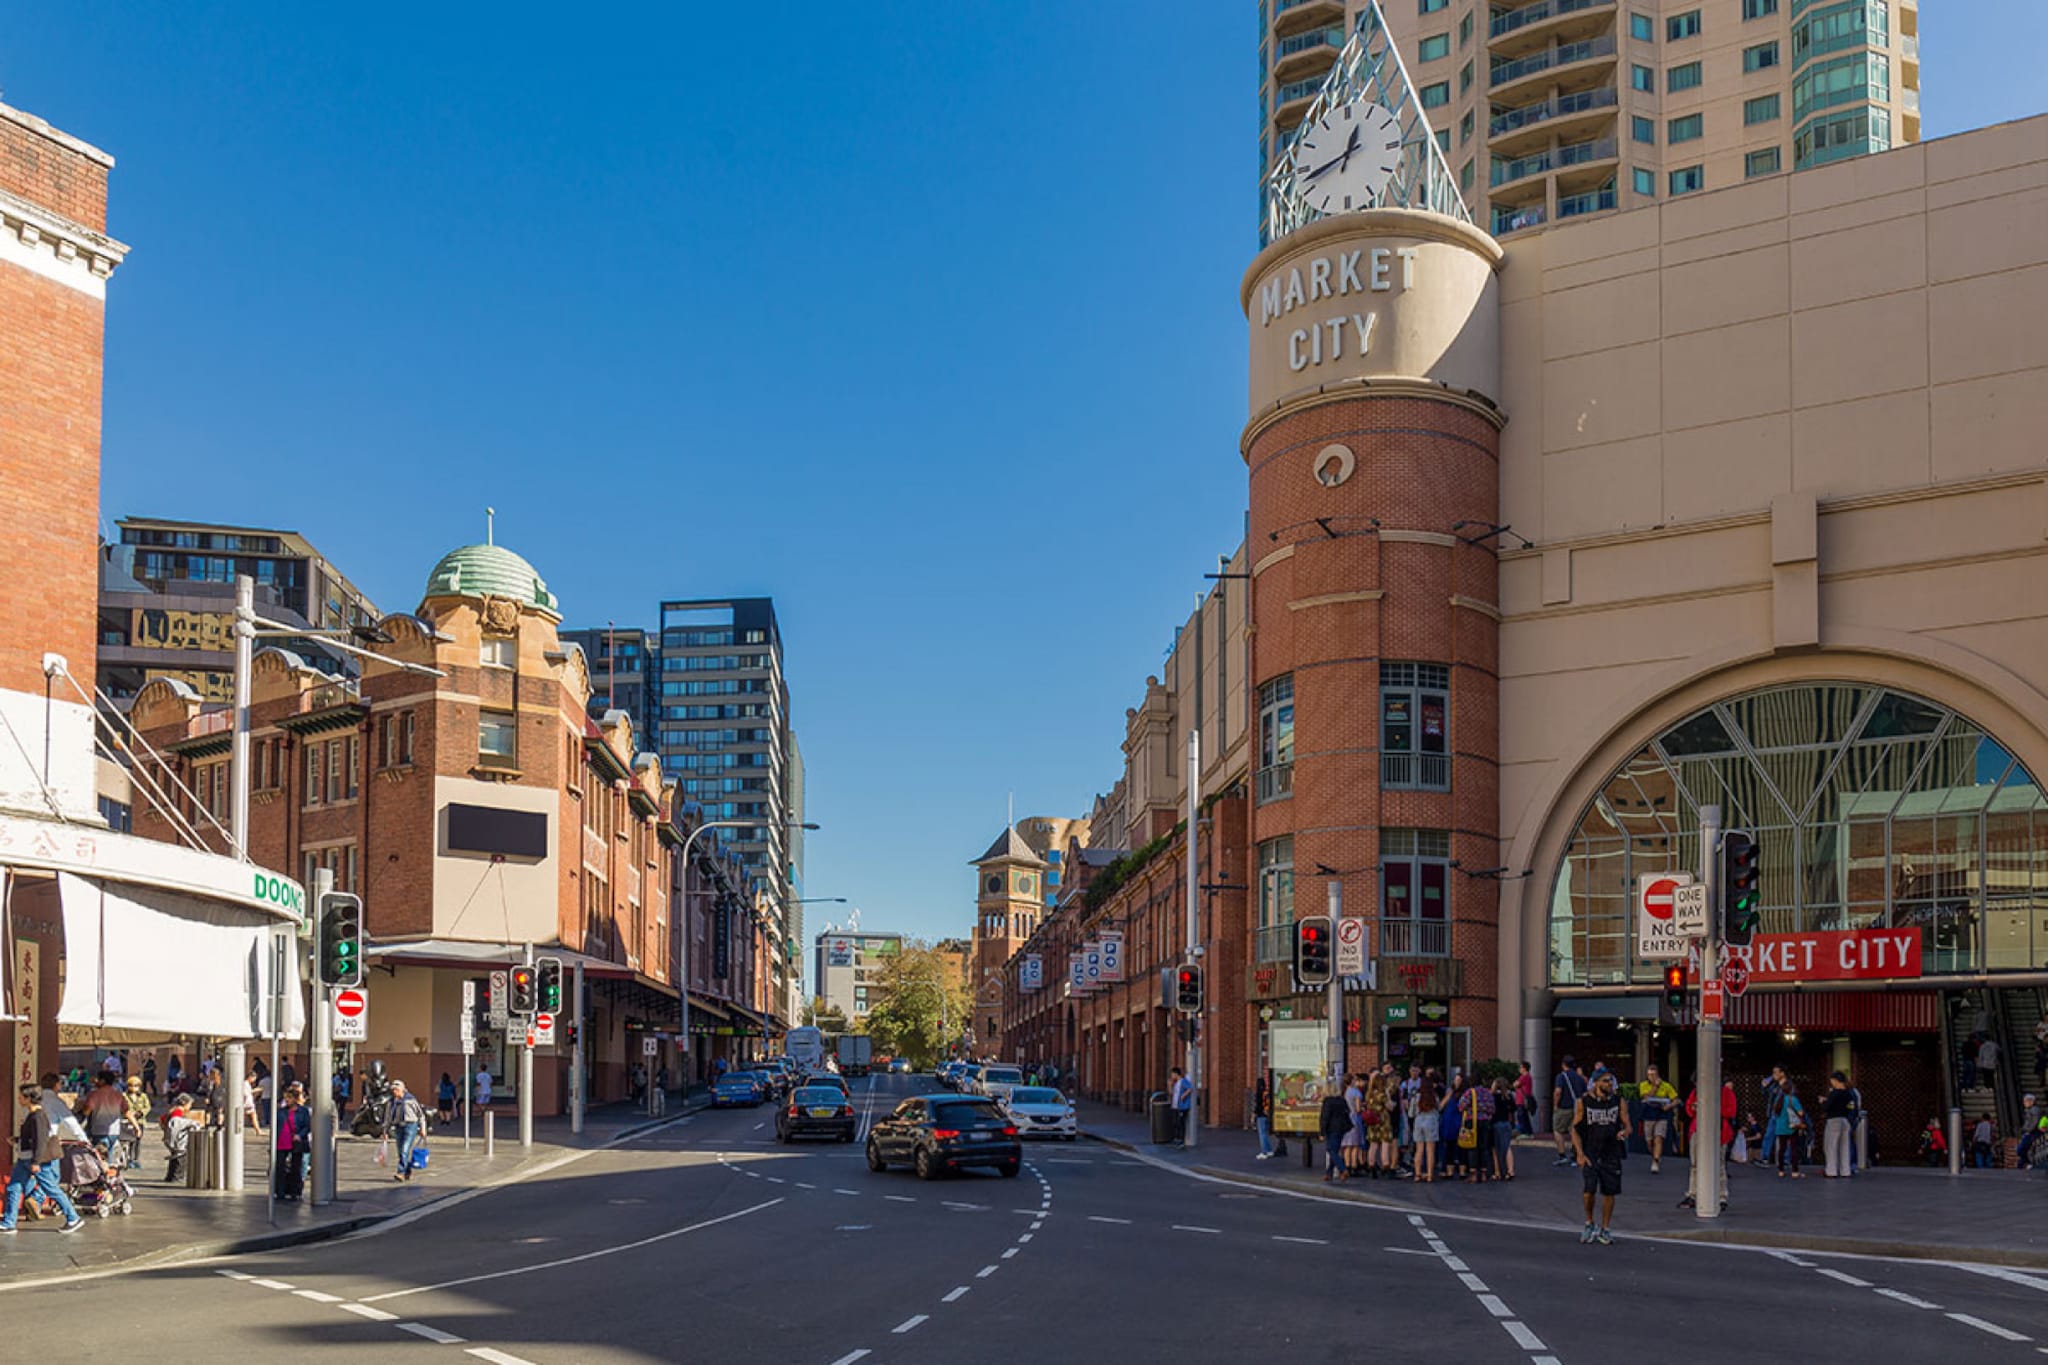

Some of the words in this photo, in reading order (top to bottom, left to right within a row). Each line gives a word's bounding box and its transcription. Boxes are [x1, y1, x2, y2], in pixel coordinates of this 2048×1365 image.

[1261, 247, 1418, 328] MARKET
[1288, 312, 1376, 372] CITY
[1678, 888, 1701, 902] ONE
[1678, 905, 1702, 918] WAY
[1651, 923, 1674, 936] NO
[1342, 946, 1358, 955] NO
[1642, 939, 1685, 952] ENTRY
[1839, 936, 1912, 970] CITY
[1725, 969, 1747, 983] STOP
[1388, 1007, 1407, 1018] TAB
[341, 1018, 357, 1028] NO
